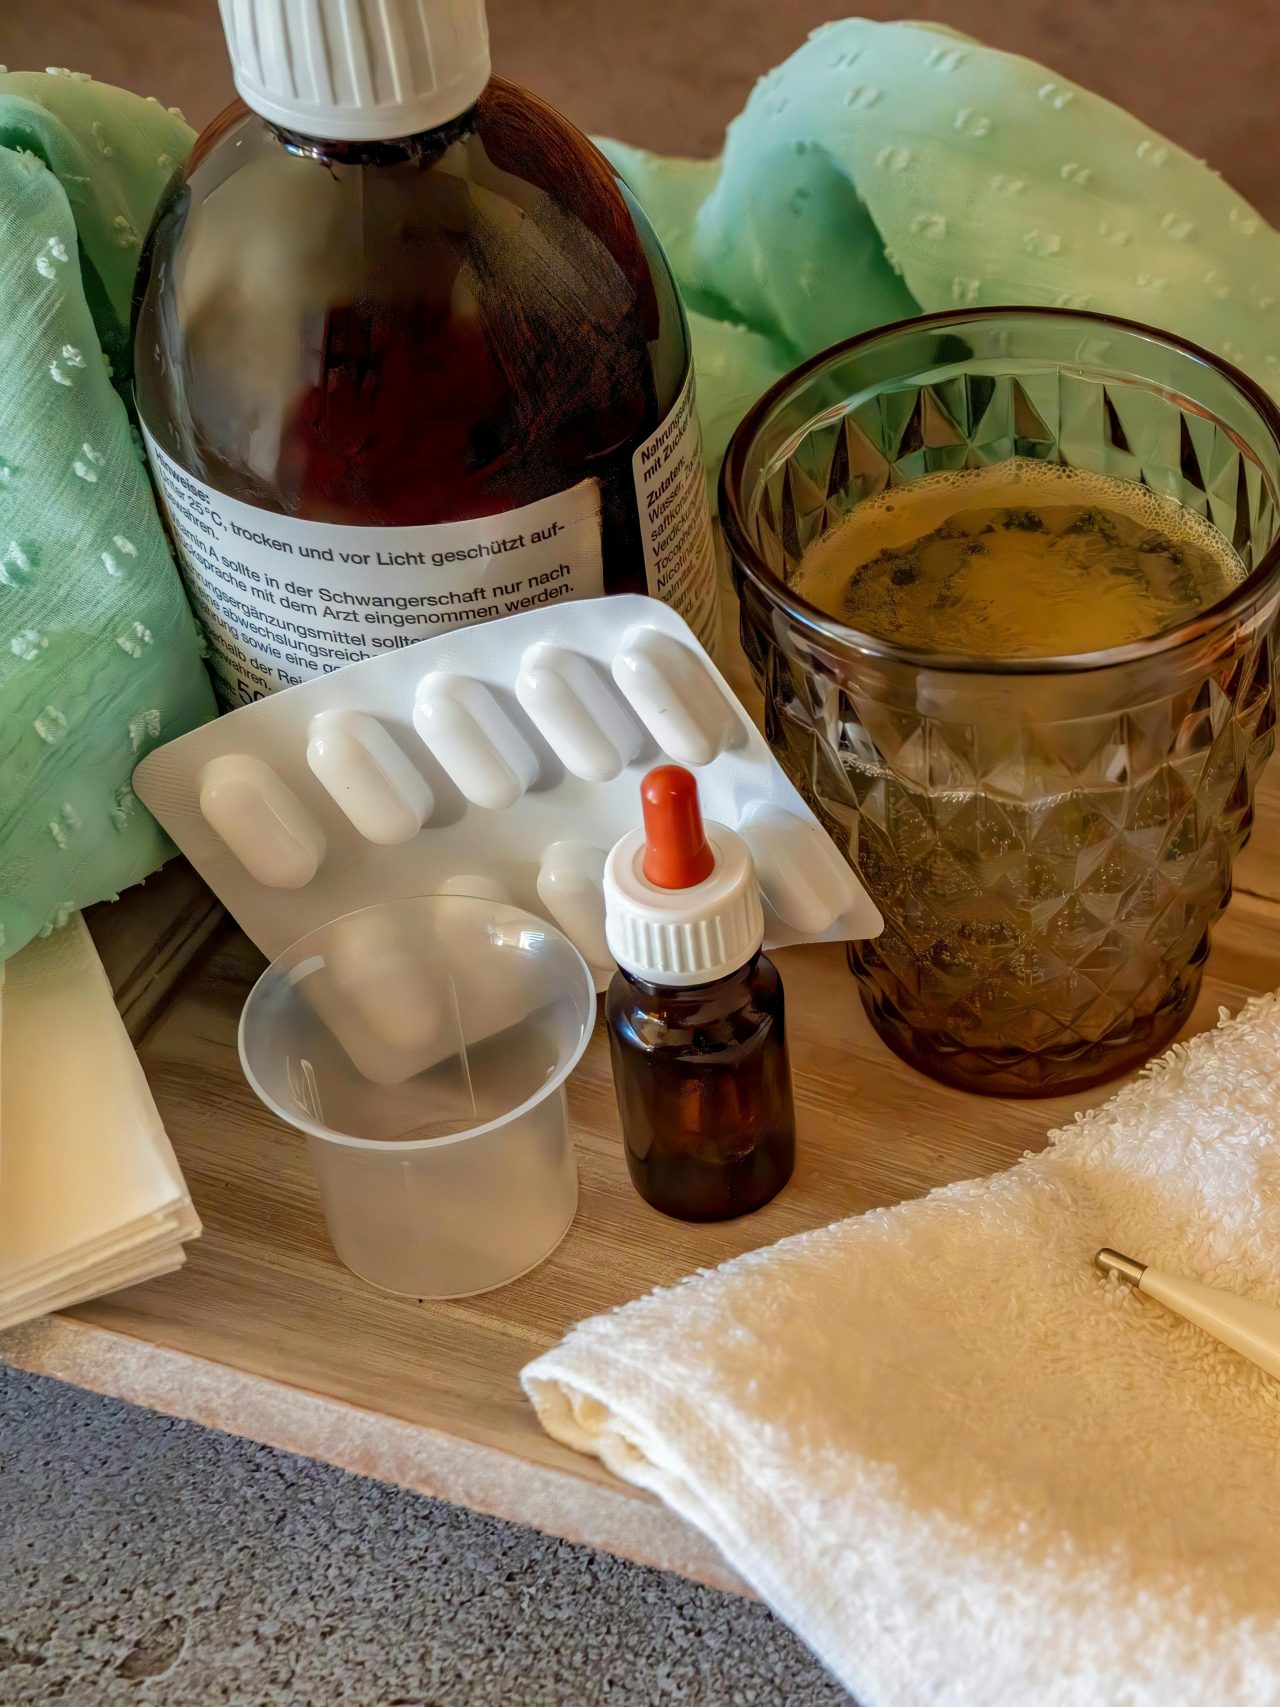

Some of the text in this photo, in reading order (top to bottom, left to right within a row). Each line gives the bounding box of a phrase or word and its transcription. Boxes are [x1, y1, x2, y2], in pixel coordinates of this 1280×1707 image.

[643, 414, 688, 482] mit Zucker
[646, 455, 685, 508] Zutaten:
[648, 480, 684, 524] Wasser,
[187, 482, 228, 532] 25°C,
[230, 520, 293, 554] trocken
[298, 545, 334, 562] und
[339, 552, 371, 566] vor
[376, 552, 426, 566] Licht
[431, 534, 526, 567] geschützt
[530, 521, 565, 545] auf-
[209, 545, 219, 561] A
[221, 556, 261, 582] sollte
[264, 573, 280, 590] in
[284, 581, 314, 598] der
[318, 587, 486, 610] Schwangerschaft
[492, 581, 523, 598] nur
[528, 564, 571, 589] nach
[250, 585, 276, 604] mit
[280, 596, 317, 616] dem
[323, 605, 360, 623] Arzt
[364, 604, 499, 627] eingenommen
[505, 582, 574, 612] werden.
[222, 606, 379, 662] abwechslungsreich
[241, 632, 281, 658] sowie
[286, 652, 318, 671] eine
[250, 658, 273, 676] der
[277, 667, 305, 686] Rei
